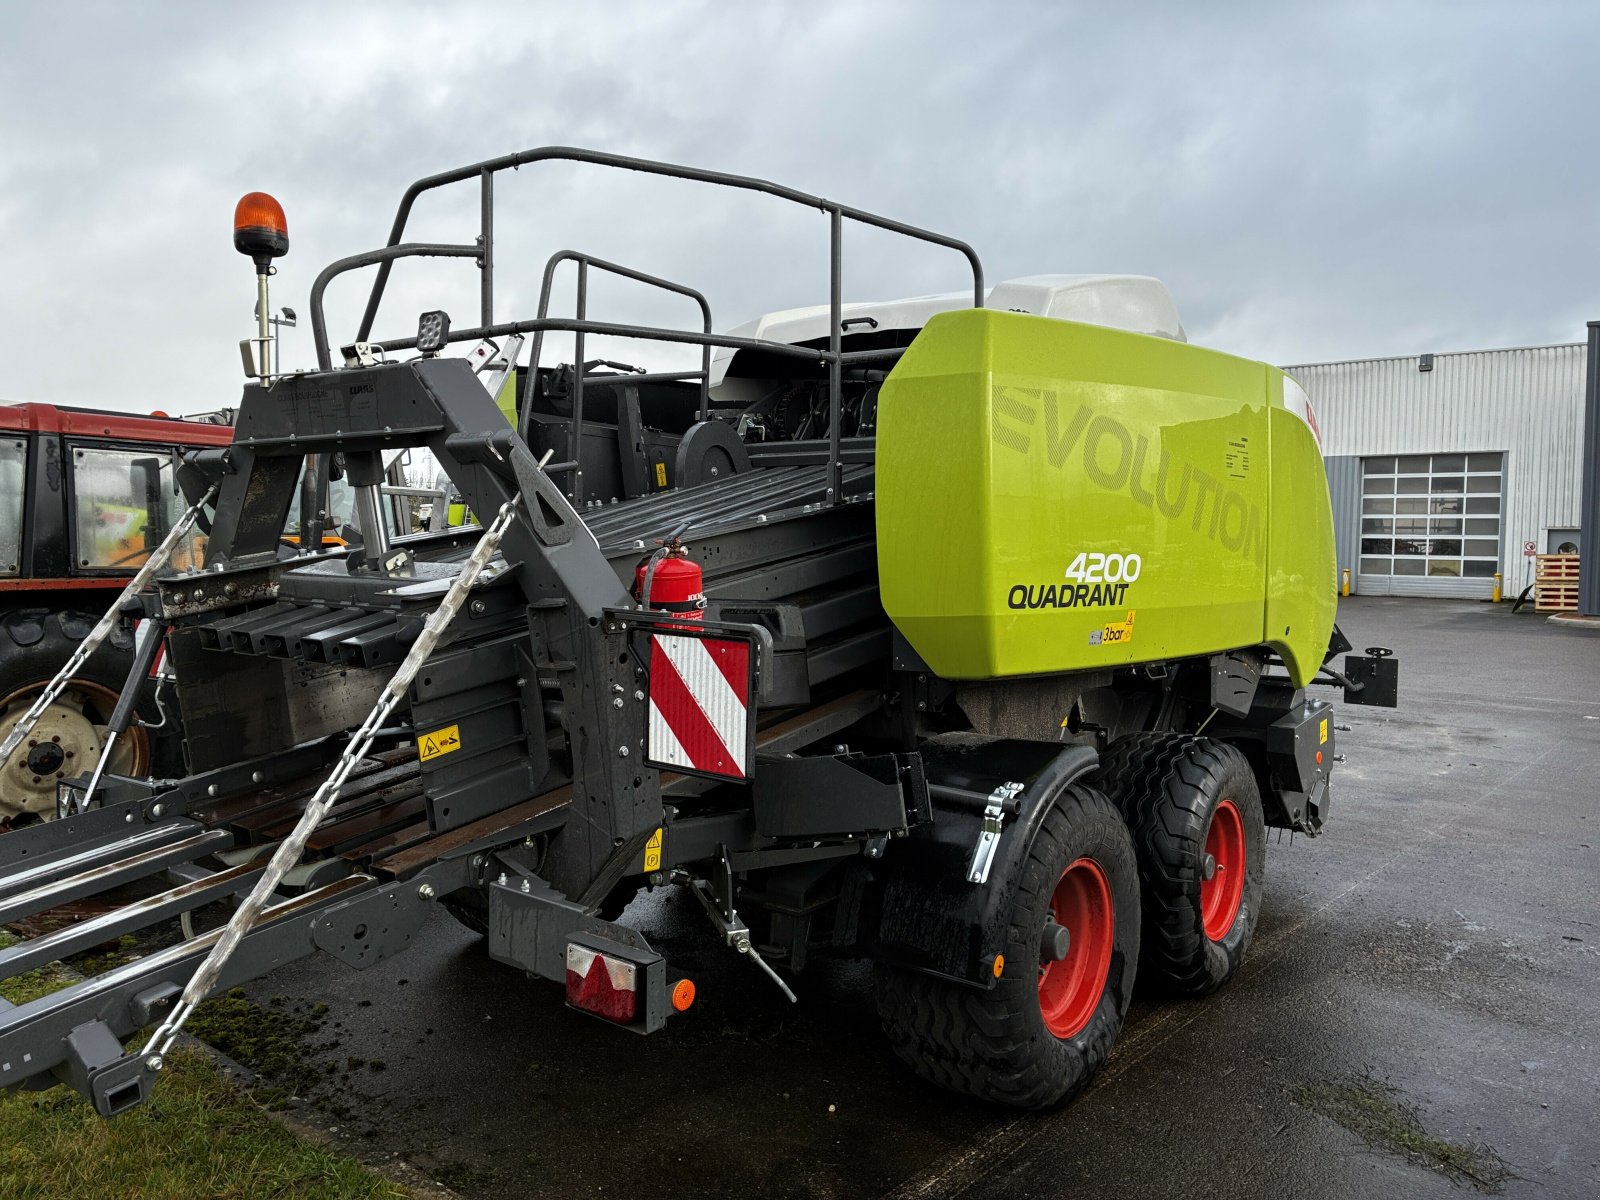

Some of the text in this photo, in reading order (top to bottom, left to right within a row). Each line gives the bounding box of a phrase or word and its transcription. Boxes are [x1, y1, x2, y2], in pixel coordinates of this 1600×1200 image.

[992, 385, 1265, 567] EVOLUTION
[1065, 553, 1141, 583] 4200
[1008, 583, 1129, 610] QUADRANT
